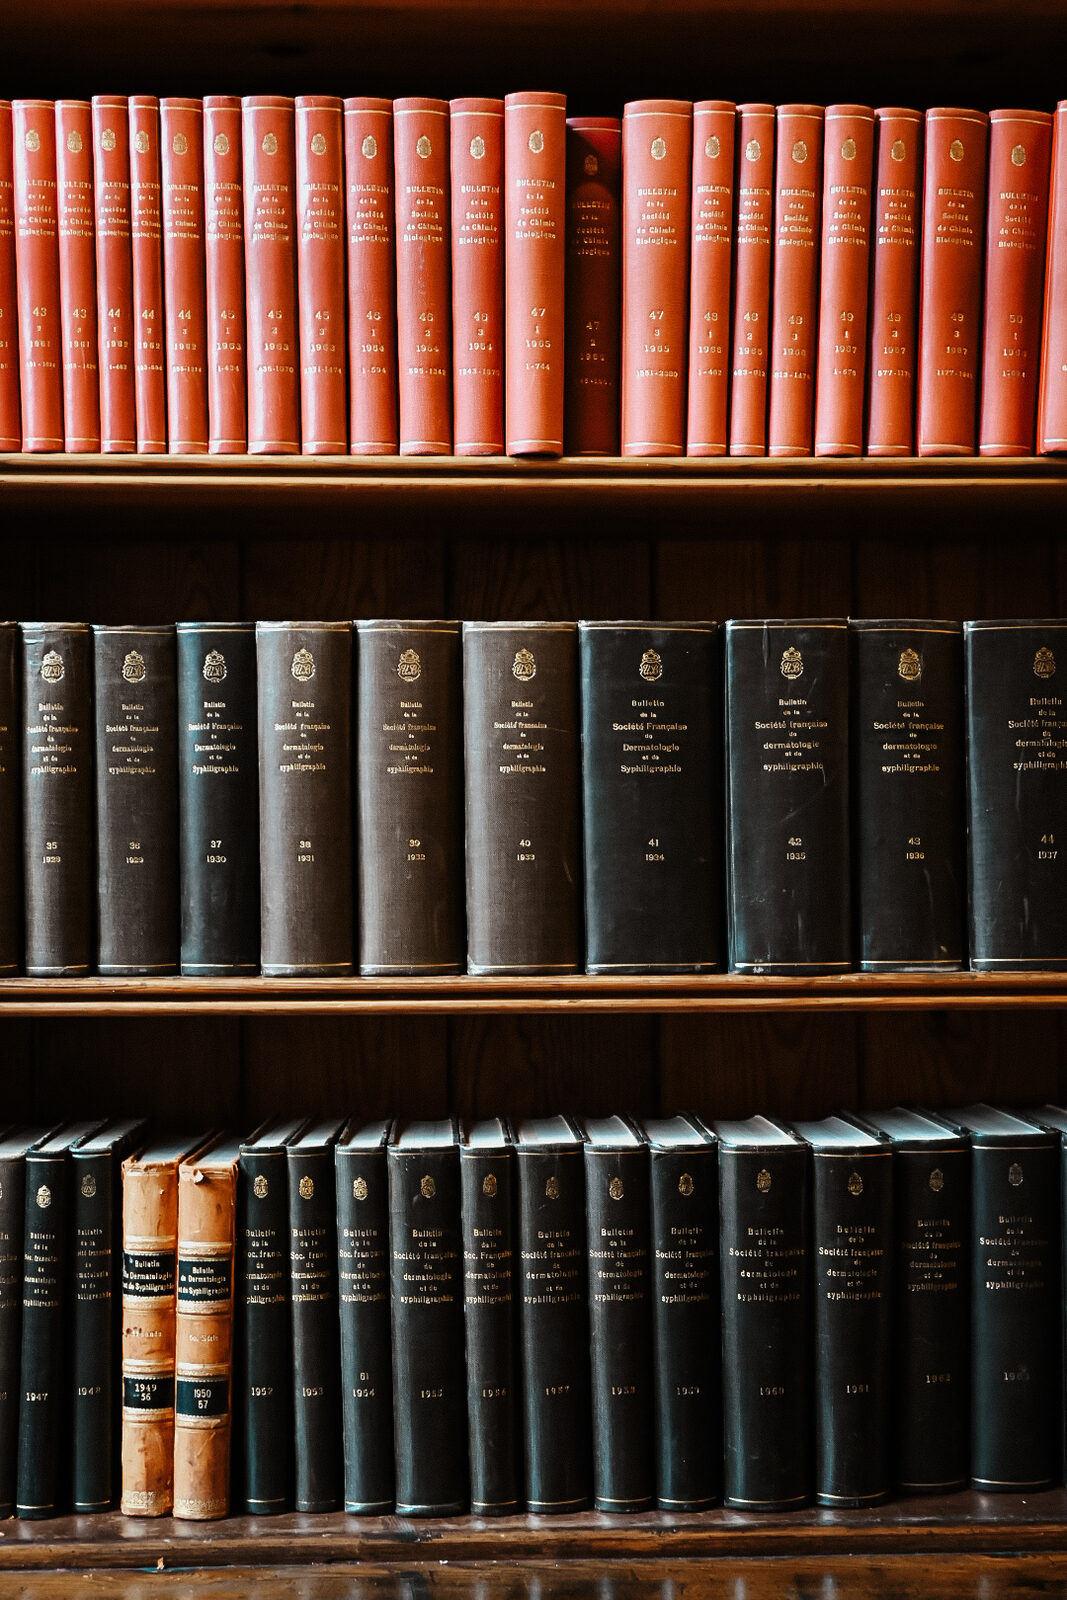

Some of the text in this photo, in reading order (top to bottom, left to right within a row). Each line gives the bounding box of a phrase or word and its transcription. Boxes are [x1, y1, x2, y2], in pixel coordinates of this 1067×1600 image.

[406, 186, 443, 195] BULLETIN
[32, 307, 47, 317] 43
[73, 308, 87, 319] 43
[108, 308, 121, 318] 44
[142, 309, 155, 319] 44
[178, 310, 191, 320] 44
[267, 310, 282, 319] 45
[531, 307, 546, 317] 47
[649, 310, 664, 321] 47
[703, 312, 718, 321] 48
[419, 312, 434, 322] 46
[840, 312, 854, 322] 49
[950, 313, 964, 322] 49
[586, 321, 600, 330] 47
[778, 698, 807, 706] Bulletin
[1029, 697, 1062, 706] Bulletin
[612, 722, 688, 732] Société Française
[755, 721, 828, 731] Société française
[873, 721, 944, 732] Société française
[1008, 719, 1039, 729] Société
[622, 743, 680, 752] Dermatologie
[763, 741, 820, 750] dermatologie
[882, 742, 937, 752] dermatologie
[620, 764, 681, 774] Syphiligraphie
[763, 762, 823, 772] syphiligraphie
[881, 764, 940, 774] syphiligraphie
[519, 839, 531, 848] 40
[648, 839, 659, 847] 41
[788, 837, 802, 846] 42
[908, 837, 921, 846] 43
[1041, 834, 1055, 844] 44
[46, 842, 57, 850] 35
[210, 840, 222, 848] 37
[206, 855, 226, 863] 1930
[297, 854, 314, 862] 1931
[517, 853, 535, 861] 1933
[645, 853, 665, 861] 1934
[786, 852, 806, 860] 1935
[906, 852, 925, 860] 1936
[1037, 851, 1058, 859] 1937
[412, 1229, 443, 1238] Bulletin
[134, 1260, 160, 1268] Bulletin
[130, 1272, 172, 1280] Dermatologie
[360, 1372, 369, 1381] 61
[135, 1384, 157, 1392] 1949
[26, 1392, 48, 1401] 1947
[141, 1393, 151, 1401] 56
[194, 1389, 211, 1398] 1950
[352, 1388, 375, 1398] 1954
[198, 1400, 208, 1409] 57
